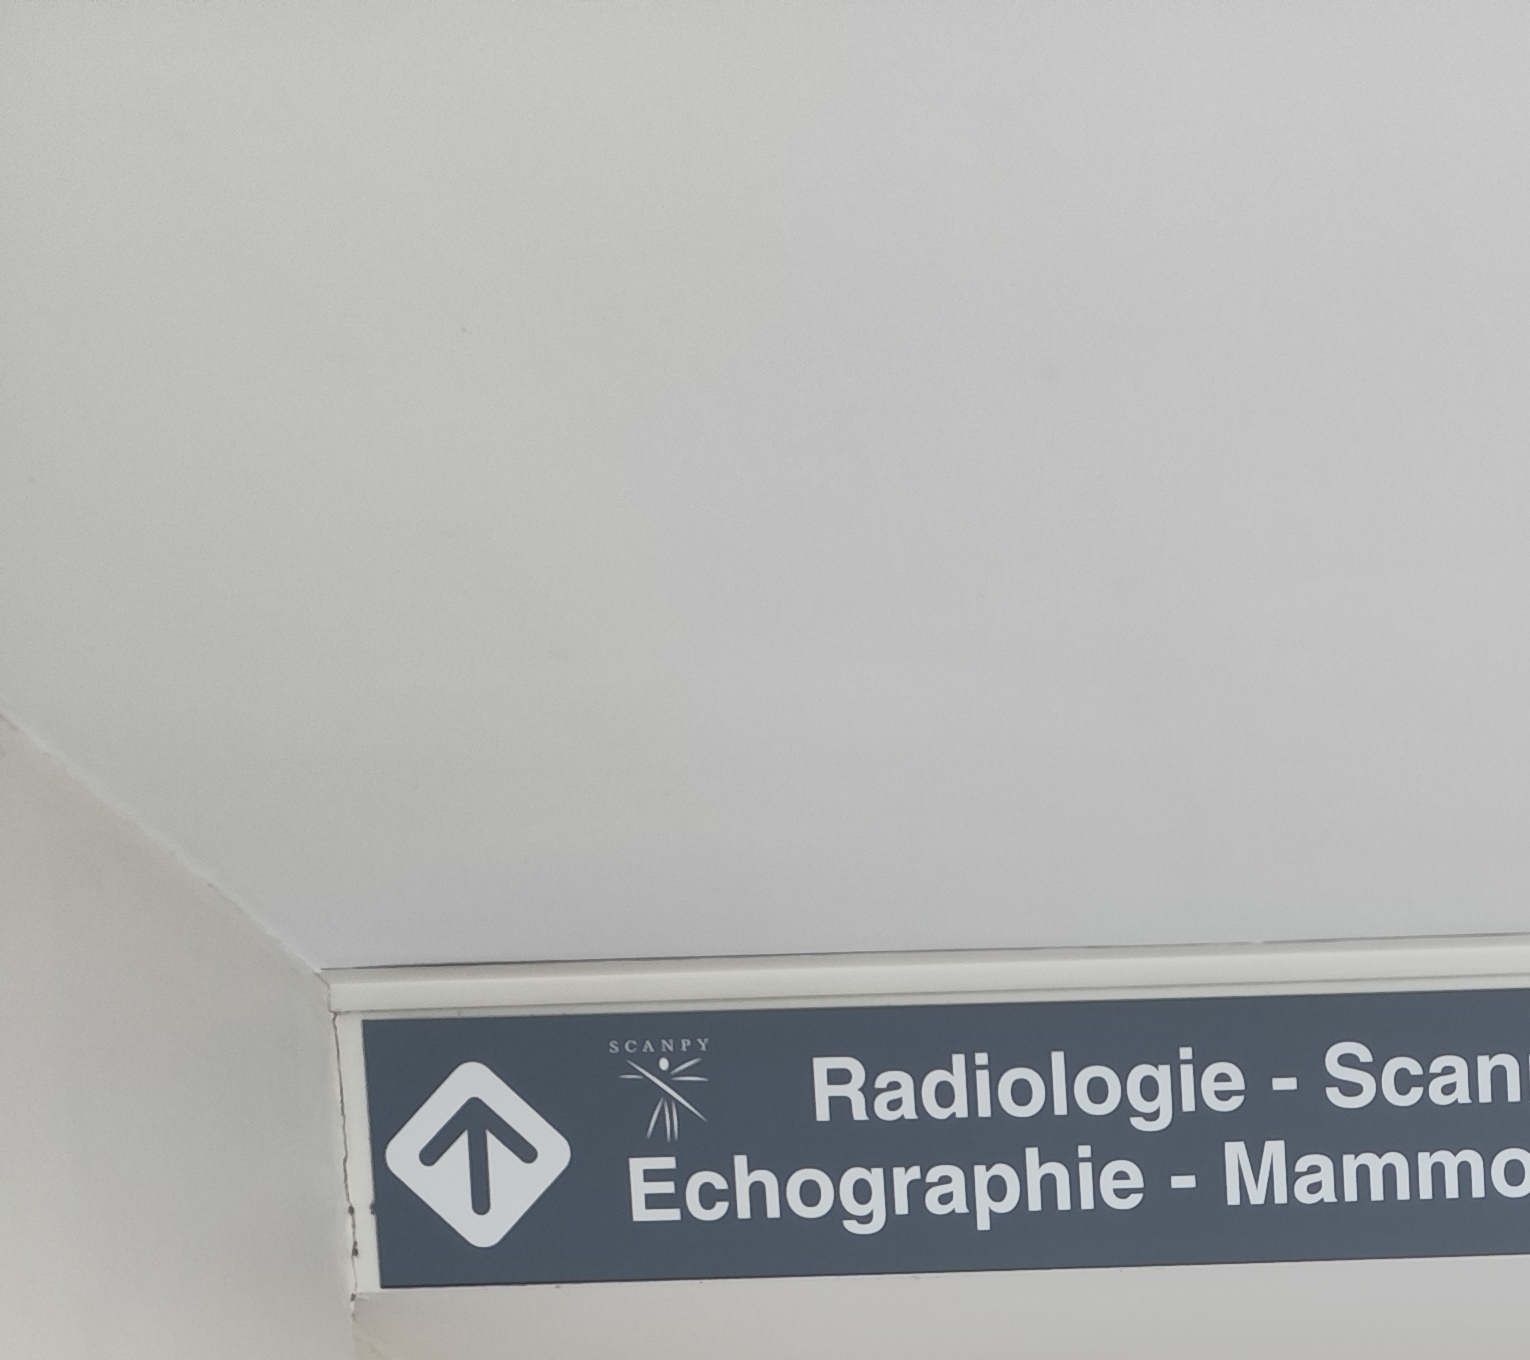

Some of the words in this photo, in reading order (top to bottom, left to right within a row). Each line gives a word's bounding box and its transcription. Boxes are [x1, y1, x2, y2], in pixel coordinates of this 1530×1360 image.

[608, 1037, 709, 1054] SCANPY
[812, 1046, 1247, 1132] Radiologie
[628, 1145, 1145, 1235] Echographie
